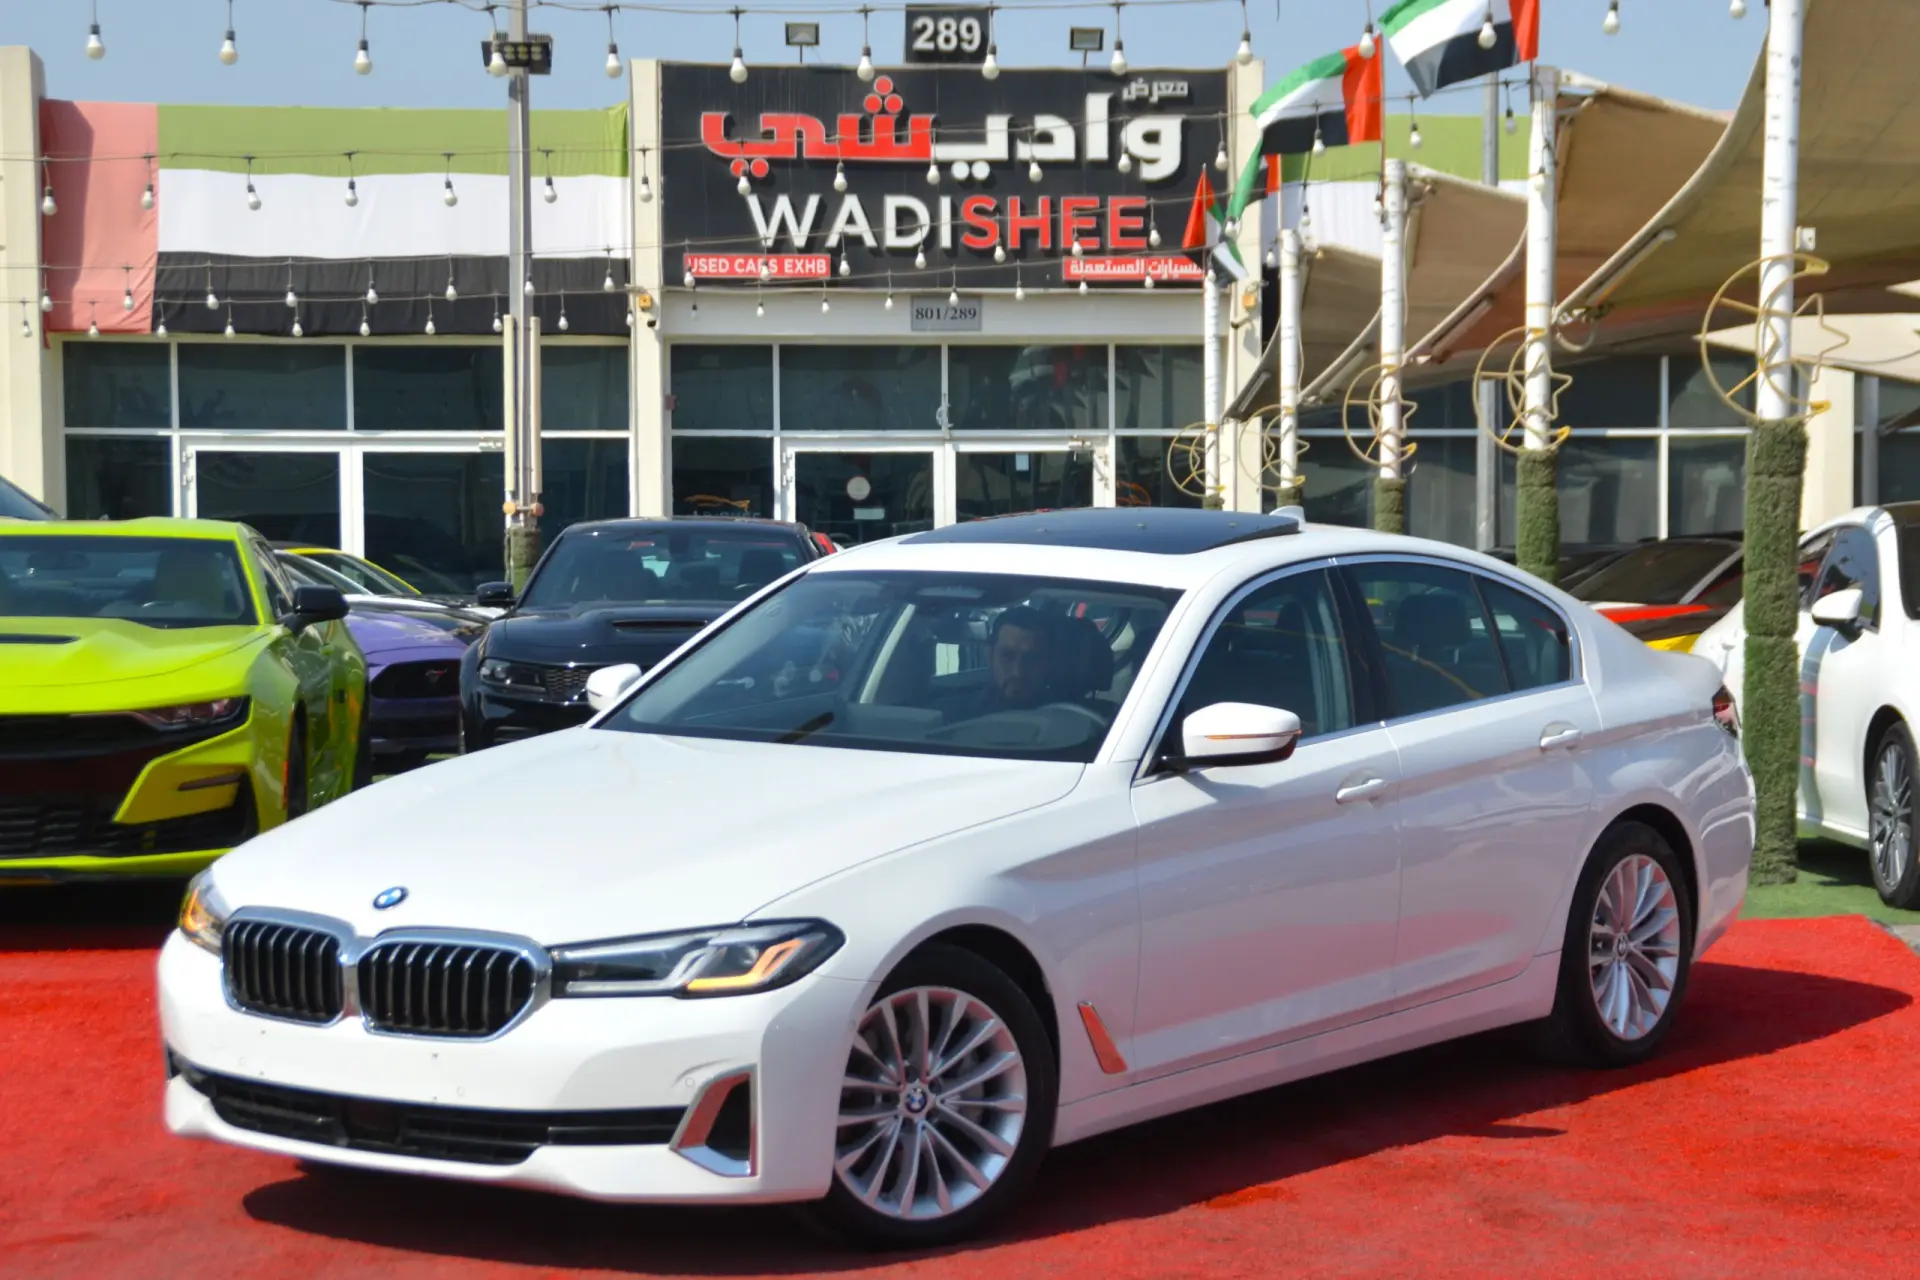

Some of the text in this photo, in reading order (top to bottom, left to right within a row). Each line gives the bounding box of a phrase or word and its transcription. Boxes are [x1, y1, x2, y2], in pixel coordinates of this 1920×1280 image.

[912, 16, 981, 52] 289
[1122, 77, 1188, 103] معرض
[747, 194, 1148, 249] WADISHEE
[688, 258, 729, 273] USED
[784, 258, 827, 274] EXHB
[915, 306, 977, 320] 801/289
